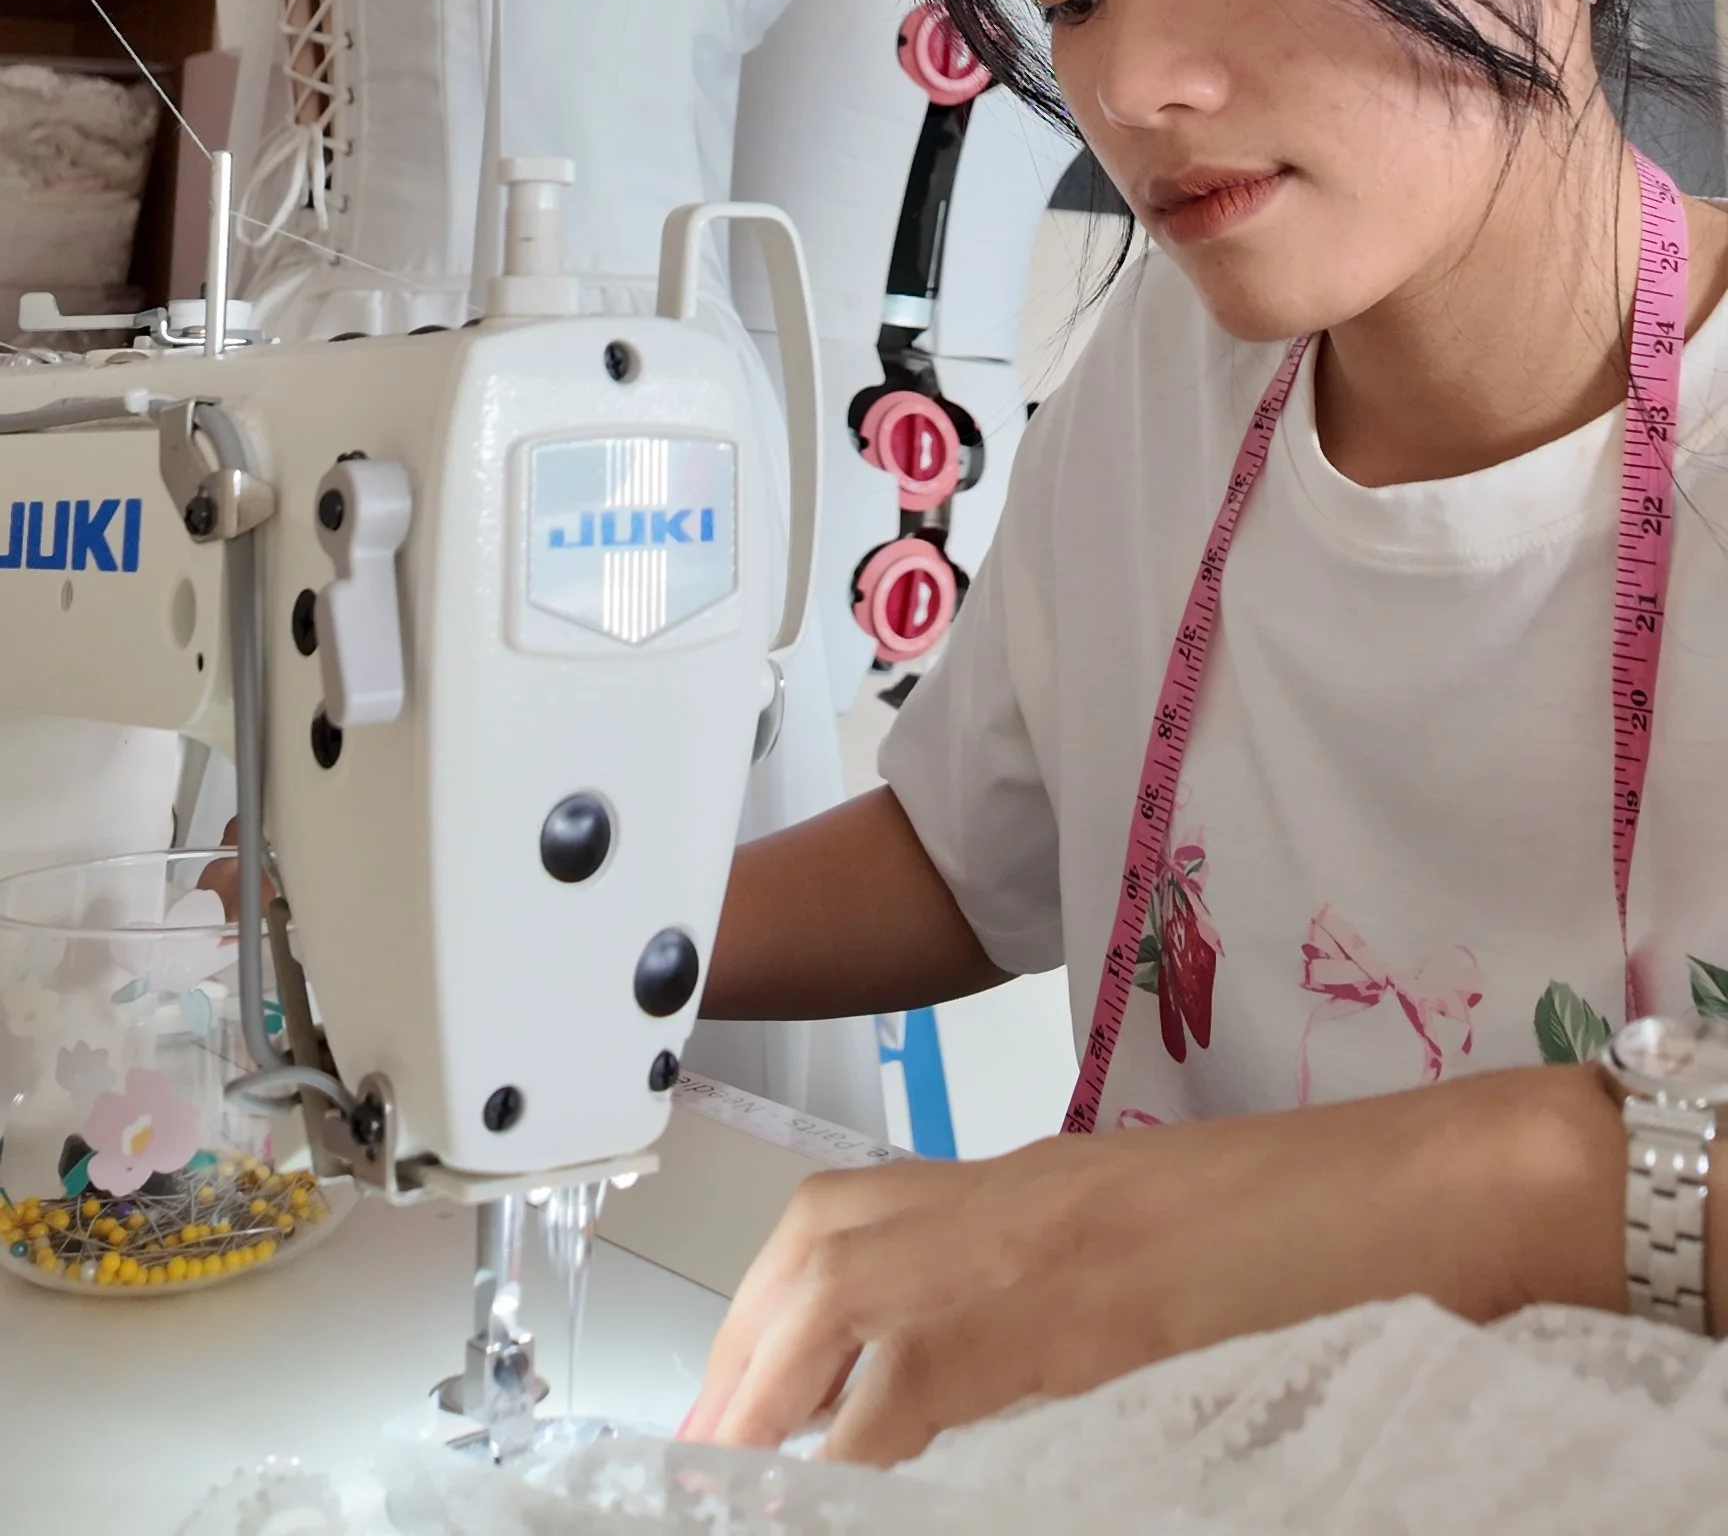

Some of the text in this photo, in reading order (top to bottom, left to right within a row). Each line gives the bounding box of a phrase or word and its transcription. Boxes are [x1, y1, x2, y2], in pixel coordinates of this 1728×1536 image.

[1660, 241, 1680, 273] 25
[1653, 321, 1675, 355] 24
[1648, 406, 1669, 442] 23
[548, 507, 714, 549] JUKI
[1642, 495, 1663, 536] 22
[0, 498, 142, 573] JUKI
[1201, 548, 1218, 582] 36
[1636, 594, 1658, 633] 21
[1178, 625, 1196, 662] 37
[1158, 704, 1177, 740] 38
[1630, 689, 1648, 731] 20
[1141, 784, 1159, 820] 39
[1624, 790, 1639, 829] 19
[1126, 864, 1140, 900] 40
[1108, 944, 1124, 978] 41
[1091, 1024, 1106, 1059] 42
